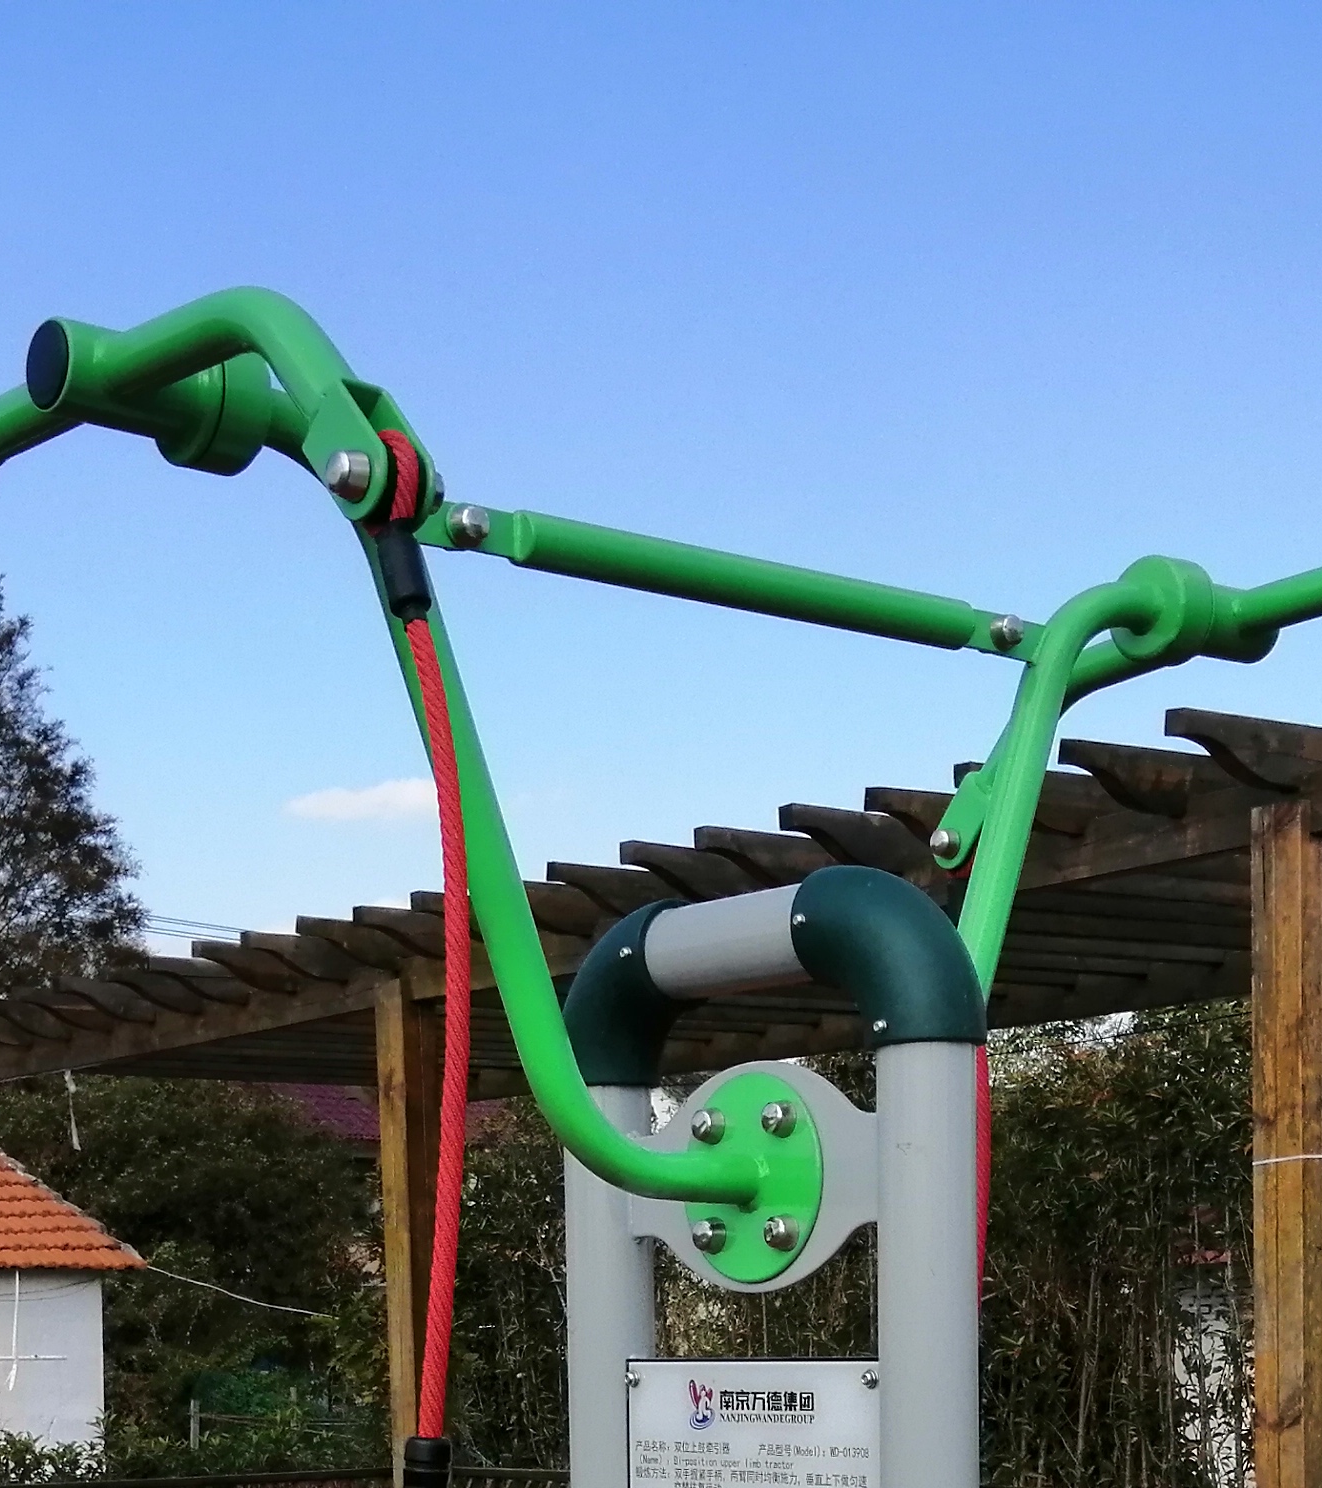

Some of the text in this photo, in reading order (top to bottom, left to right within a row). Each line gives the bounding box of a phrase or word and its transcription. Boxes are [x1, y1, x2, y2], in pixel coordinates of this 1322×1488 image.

[719, 1388, 814, 1412] 南京万德集团
[764, 1459, 794, 1470] tractor
